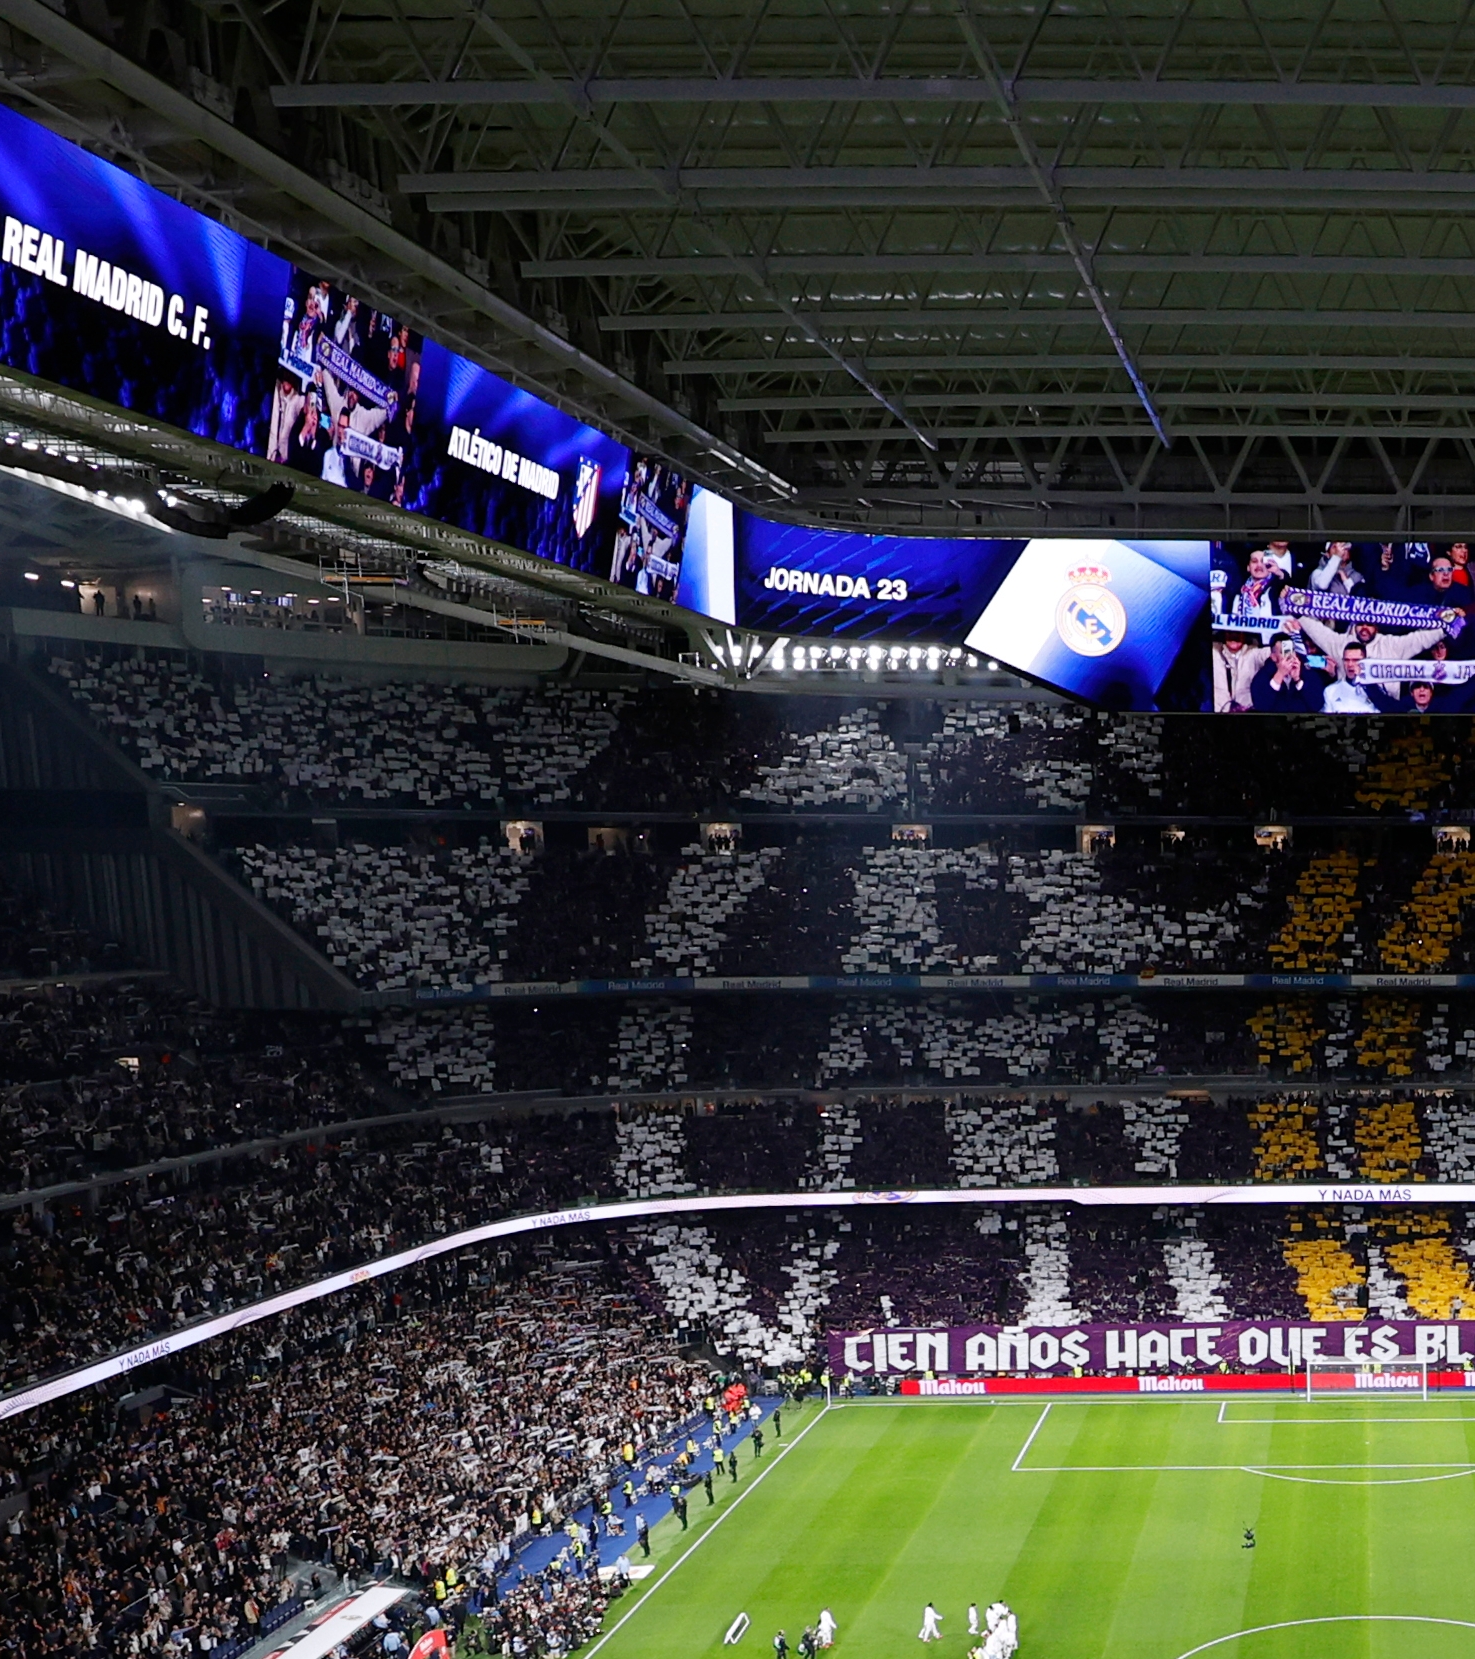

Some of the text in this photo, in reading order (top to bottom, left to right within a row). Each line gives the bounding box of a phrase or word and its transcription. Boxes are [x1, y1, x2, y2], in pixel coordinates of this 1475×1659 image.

[2, 215, 211, 349] REAL MADRID C. F.
[447, 425, 560, 500] ATLÉTICO DE MADRID
[764, 566, 908, 601] JORNADA 23
[1312, 595, 1349, 611] REAL
[1352, 599, 1410, 617] MADRID
[1227, 614, 1280, 629] MADRID
[607, 980, 665, 990] Real Madrid
[723, 979, 743, 989] Real
[837, 977, 892, 986] Real Madrid
[947, 978, 966, 987] Real
[1057, 976, 1111, 985] Real Madrid
[1164, 977, 1219, 986] Real Madrid
[1271, 976, 1324, 985] Real Madrid
[1376, 977, 1431, 986] Real Madrid
[1318, 1186, 1412, 1200] Y NADA MÁS
[531, 1218, 537, 1228] Y
[539, 1214, 566, 1226] NADA
[844, 1331, 949, 1372] CIEN
[965, 1326, 1090, 1371] AÑOS
[1106, 1327, 1223, 1370] HACE
[1344, 1325, 1399, 1362] ES
[119, 1358, 125, 1370] Y
[127, 1349, 150, 1368] NADA
[918, 1378, 987, 1396] Mahou
[1138, 1375, 1204, 1392] Mahou
[1354, 1373, 1419, 1389] Mahou
